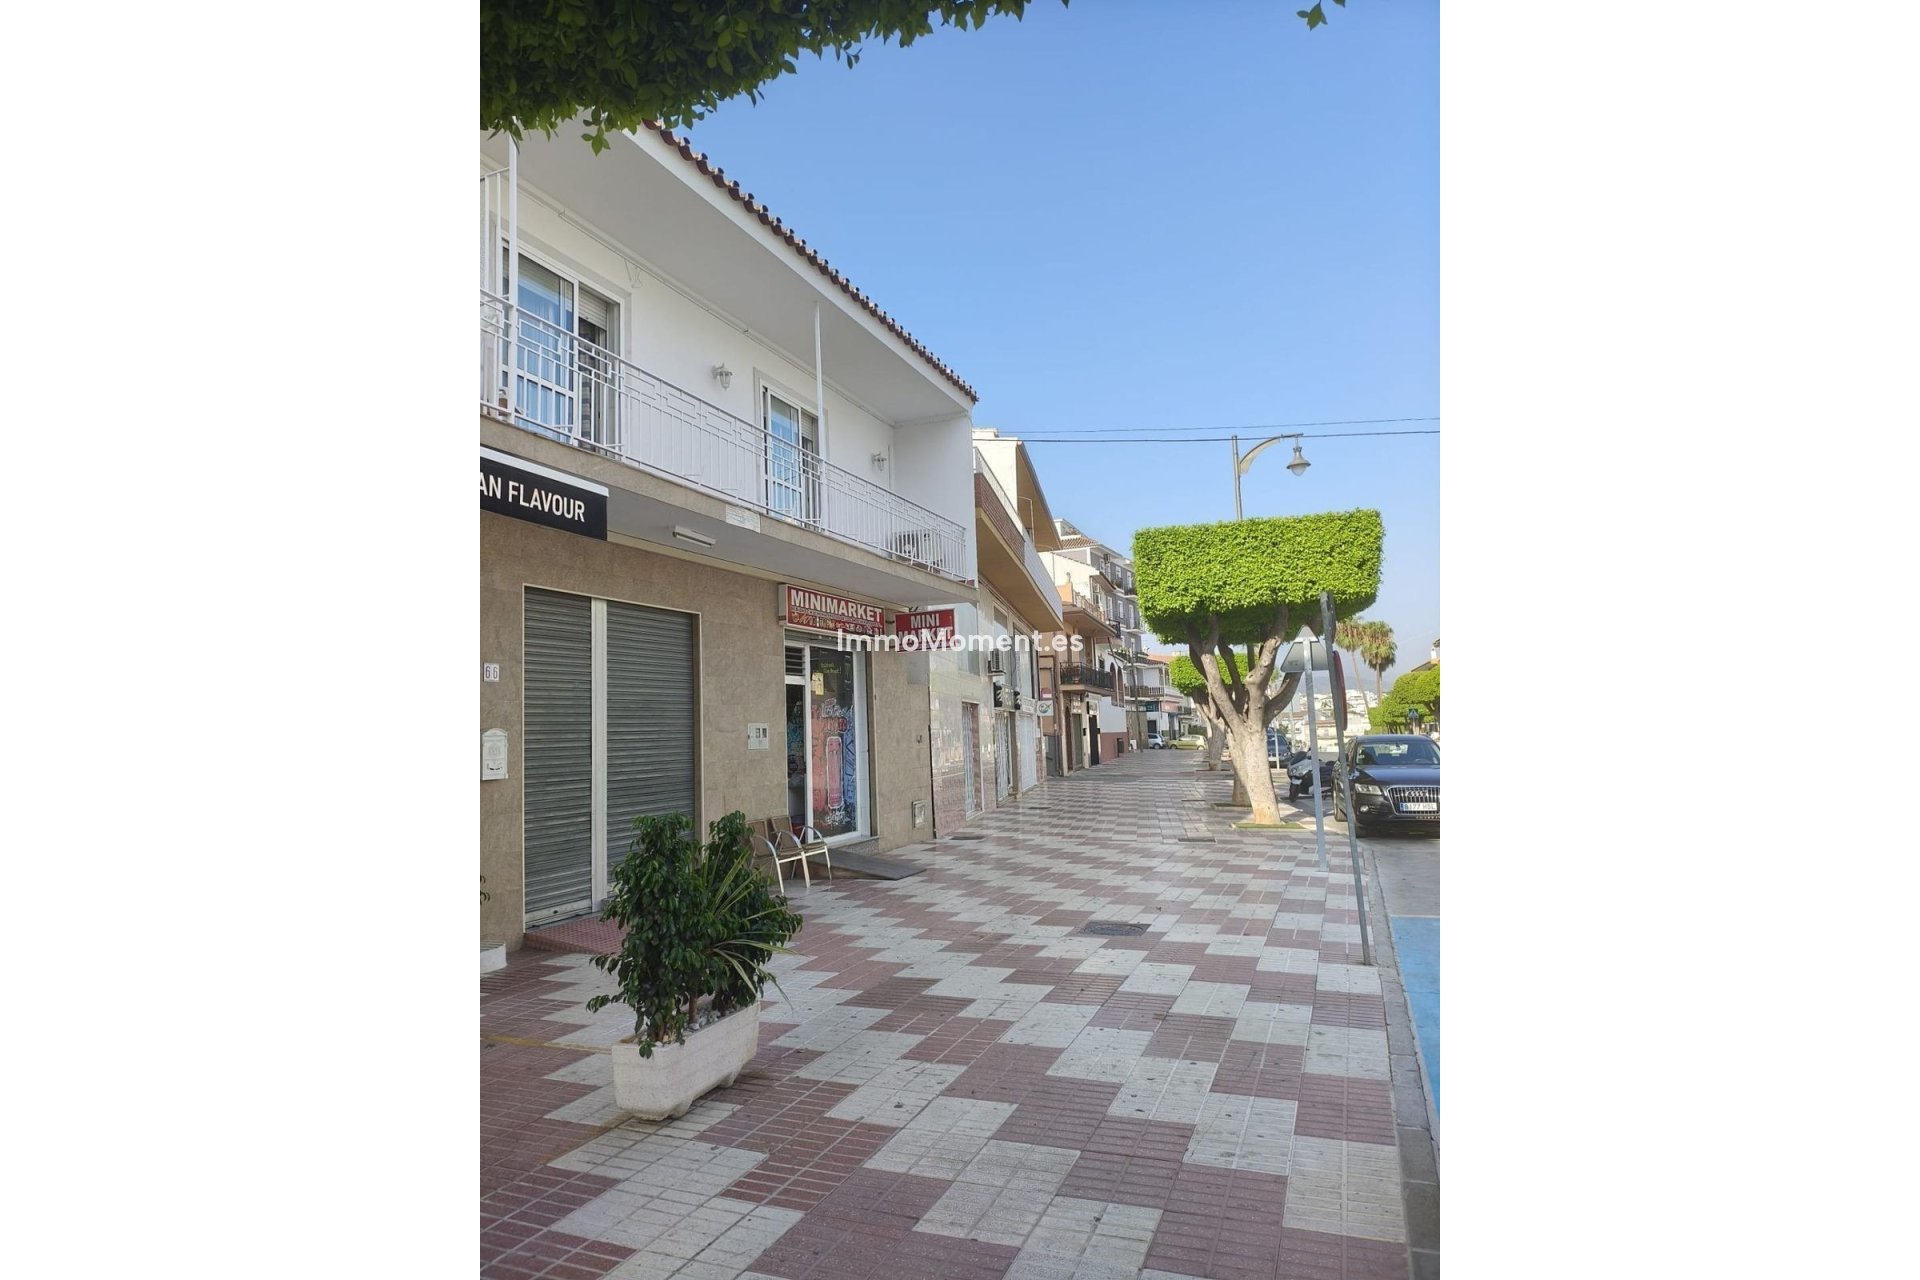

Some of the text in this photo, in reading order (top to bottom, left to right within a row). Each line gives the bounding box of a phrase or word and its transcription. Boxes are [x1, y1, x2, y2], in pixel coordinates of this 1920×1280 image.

[508, 480, 585, 522] FLAVOUR
[791, 589, 883, 623] MINIMARKET
[910, 613, 940, 629] MINI
[485, 665, 499, 679] 66
